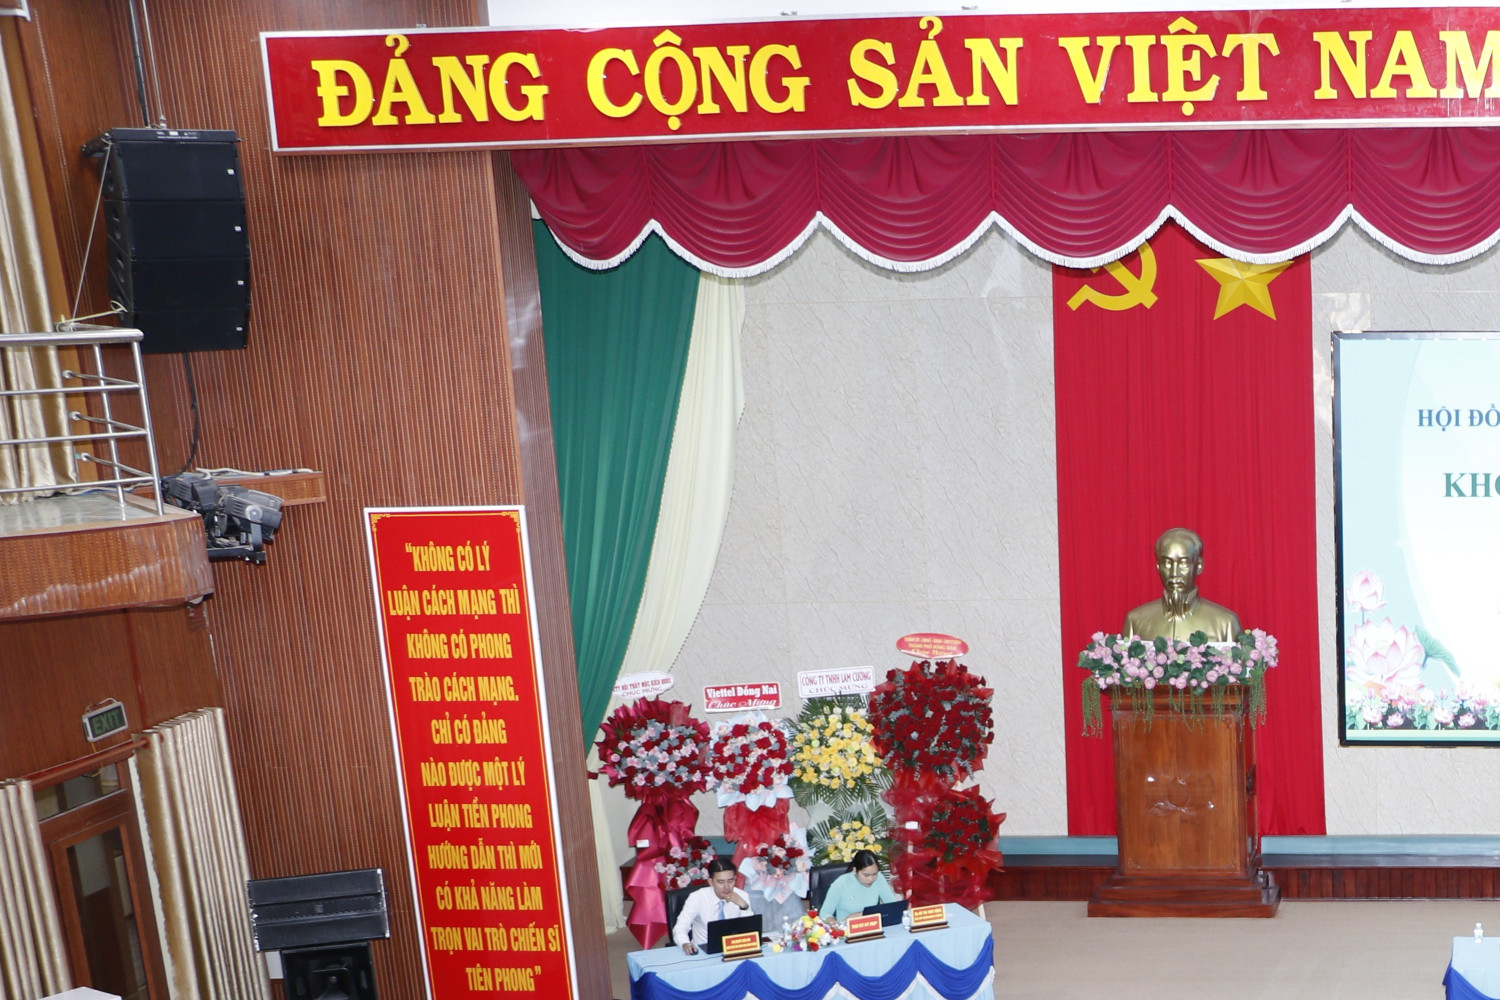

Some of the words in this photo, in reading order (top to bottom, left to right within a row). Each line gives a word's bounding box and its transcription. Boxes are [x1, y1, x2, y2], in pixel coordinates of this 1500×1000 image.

[311, 35, 548, 126] ĐẢNG
[587, 29, 810, 130] CỘNG
[847, 17, 1023, 109] SẢN
[1058, 17, 1280, 115] VIỆT
[1418, 406, 1460, 432] HỘI
[405, 541, 455, 572] “KHÔNG
[456, 540, 474, 571] CÓ
[475, 540, 490, 571] LÝ
[387, 585, 421, 620] LUẬN
[422, 584, 456, 615] CÁCH
[457, 589, 497, 620] MẠNG
[499, 583, 521, 614] THÌ
[406, 629, 449, 659] KHÔNG
[450, 629, 468, 659] CÓ
[469, 633, 513, 659] PHONG
[408, 672, 441, 702] TRÀO
[443, 672, 477, 702] CÁCH
[706, 687, 736, 698] Viettel
[762, 684, 777, 695] Nai
[802, 674, 817, 686] CÔNG
[818, 675, 825, 685] TY
[825, 673, 840, 684] TNHH
[93, 710, 121, 735] EXIT
[431, 712, 453, 744] CHỈ
[453, 714, 471, 744] CÓ
[472, 711, 508, 744] ĐẢNG
[421, 757, 447, 787] NÀO
[448, 759, 482, 791] ĐƯỢC
[482, 756, 509, 790] MỘT
[511, 756, 526, 786] LÝ
[428, 799, 461, 831] LUẬN
[461, 796, 490, 828] TIỀN
[491, 804, 533, 829] PHONG
[427, 840, 469, 869] HƯỚNG
[470, 838, 496, 869] DẪN
[497, 841, 517, 869] THÌ
[518, 840, 543, 869] MỚI
[436, 881, 453, 910] CÓ
[454, 879, 480, 910] KHẢ
[480, 882, 515, 910] NĂNG
[516, 882, 543, 910] LÀM
[430, 927, 463, 955] TRỌN
[463, 927, 483, 950] VAI
[484, 923, 508, 951] TRÒ
[510, 922, 546, 951] CHIẾN
[547, 924, 561, 952] SĨ
[466, 963, 493, 991] TIÊN
[494, 966, 541, 991] PHONG”
